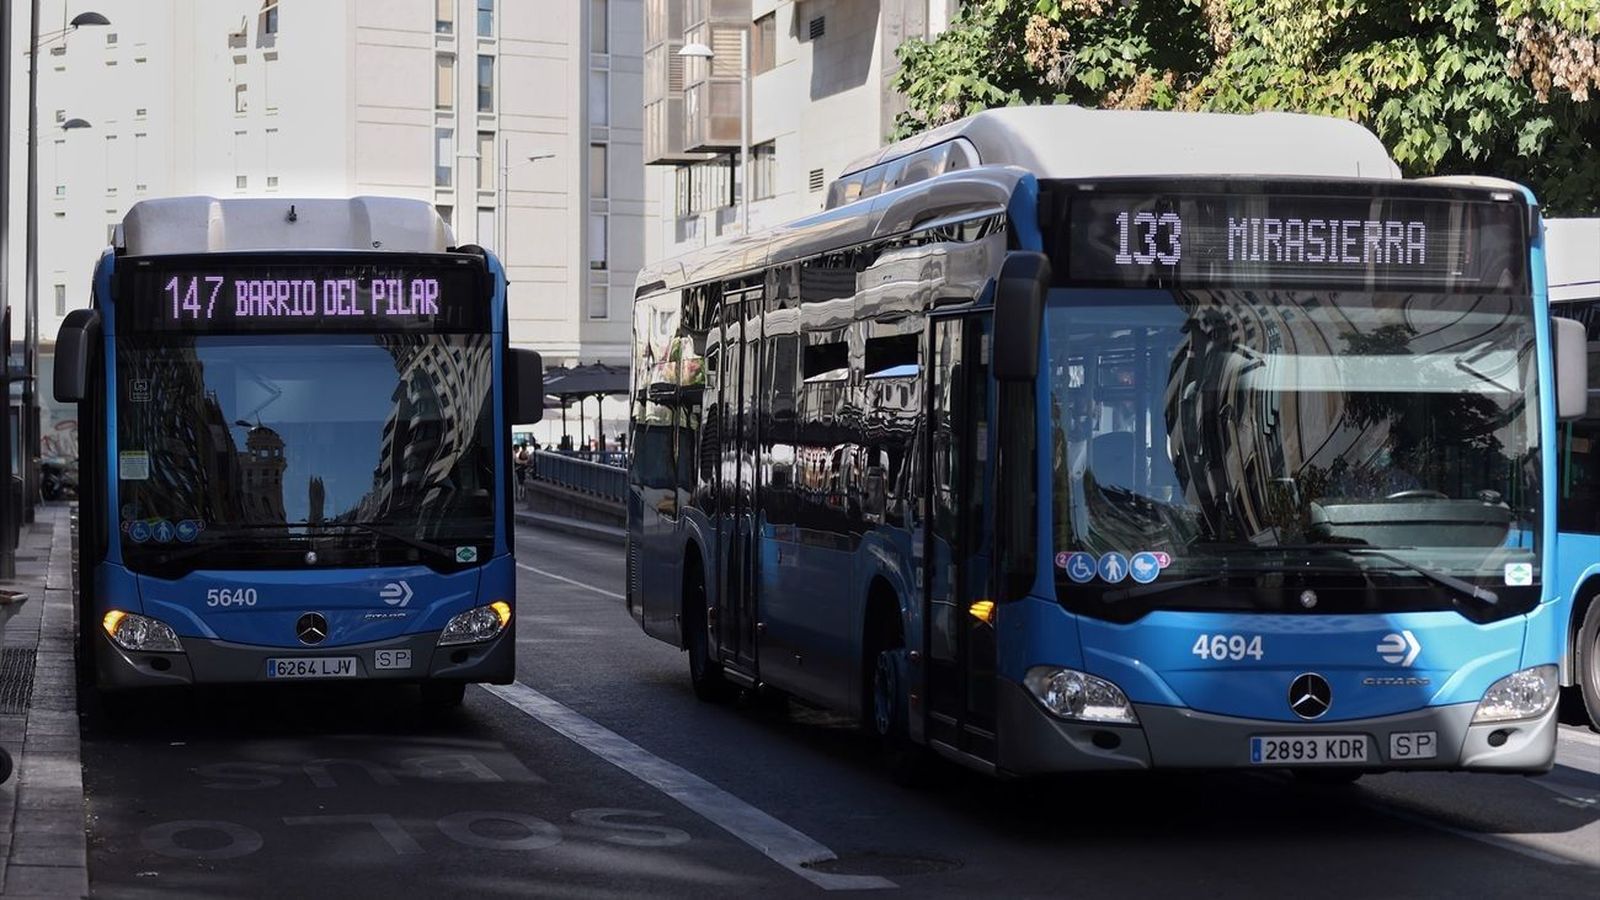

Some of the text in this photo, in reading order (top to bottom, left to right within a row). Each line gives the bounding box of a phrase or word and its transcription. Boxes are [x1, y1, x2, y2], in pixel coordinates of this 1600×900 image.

[1115, 212, 1426, 265] 133 MIRASIERRA
[165, 276, 439, 319] 147 BARRIO DEL PILAR
[206, 588, 258, 607] 5640
[1192, 635, 1264, 661] 4694
[277, 659, 352, 676] 6264 LJV
[1265, 739, 1365, 761] 2893 KDR
[139, 806, 692, 860] SOLO
